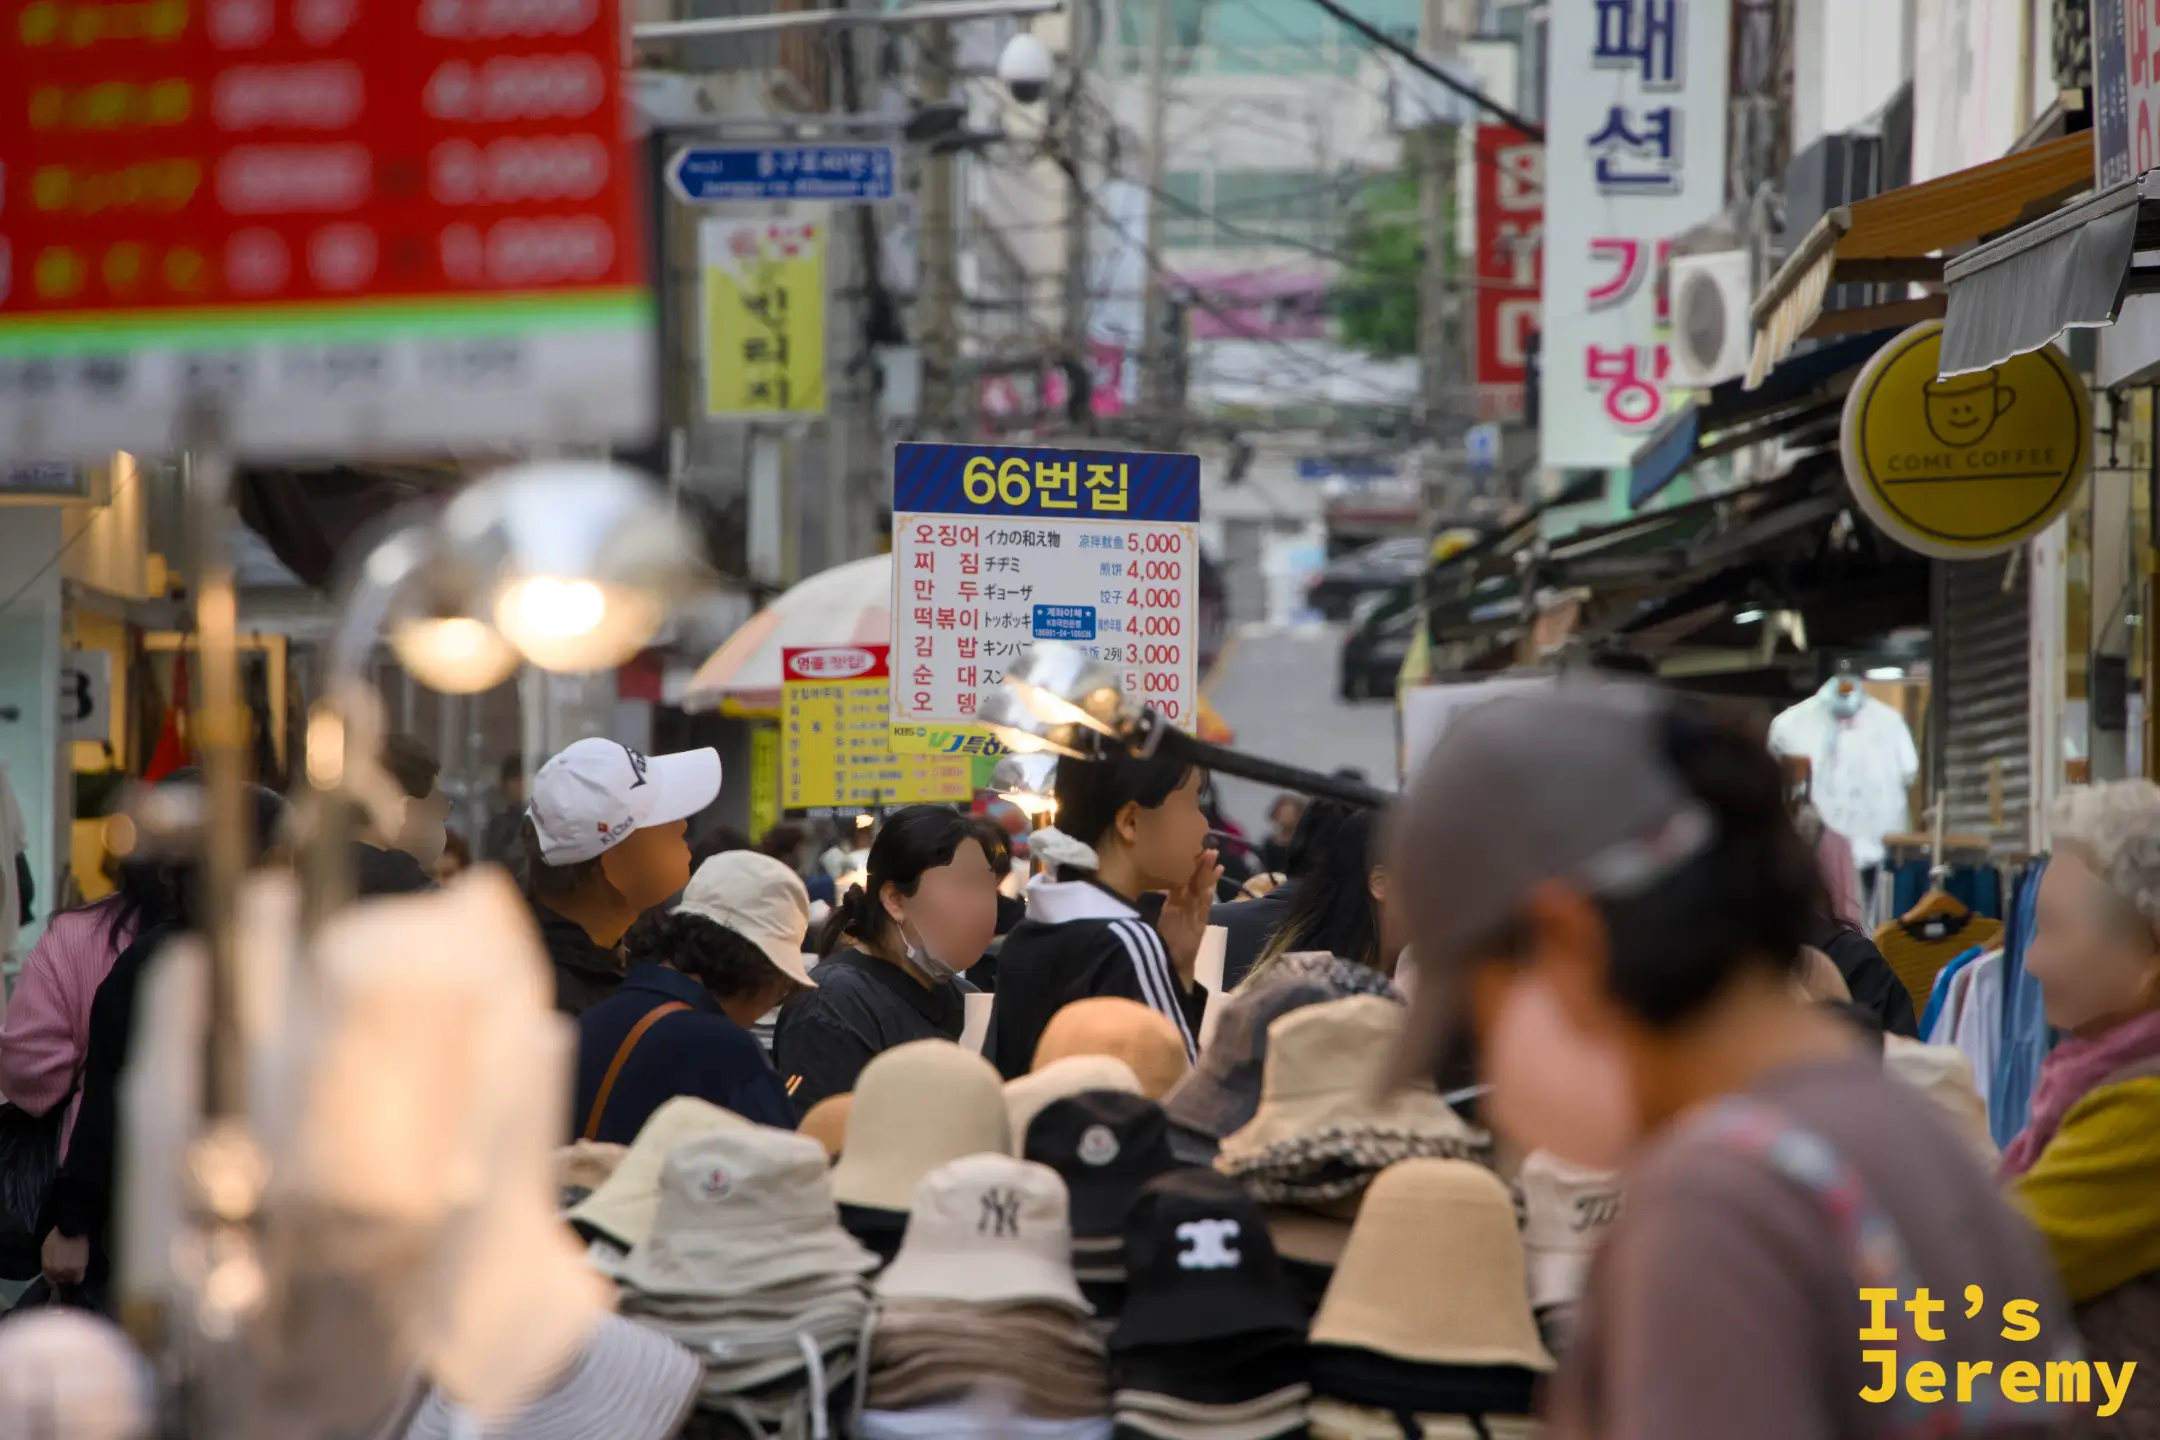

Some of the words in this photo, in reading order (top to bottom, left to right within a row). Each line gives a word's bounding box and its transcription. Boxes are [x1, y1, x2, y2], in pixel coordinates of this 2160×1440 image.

[1587, 0, 1678, 186] 패션
[1888, 454, 1953, 472] COME
[1966, 447, 2055, 469] COFFEE
[963, 456, 1128, 511] 66번집
[914, 524, 979, 548] 오징어
[984, 529, 1060, 549] イカの和え物
[1127, 533, 1181, 553] 5,000
[984, 556, 1021, 574] チヂミ
[1127, 560, 1181, 581] 4,000
[983, 583, 1033, 602] ギョーザ
[1126, 589, 1181, 610] 4,000
[914, 607, 979, 631] 떡볶이
[1126, 616, 1180, 637] 4,000
[1126, 643, 1180, 664] 3,000
[977, 1183, 1020, 1237] NY
